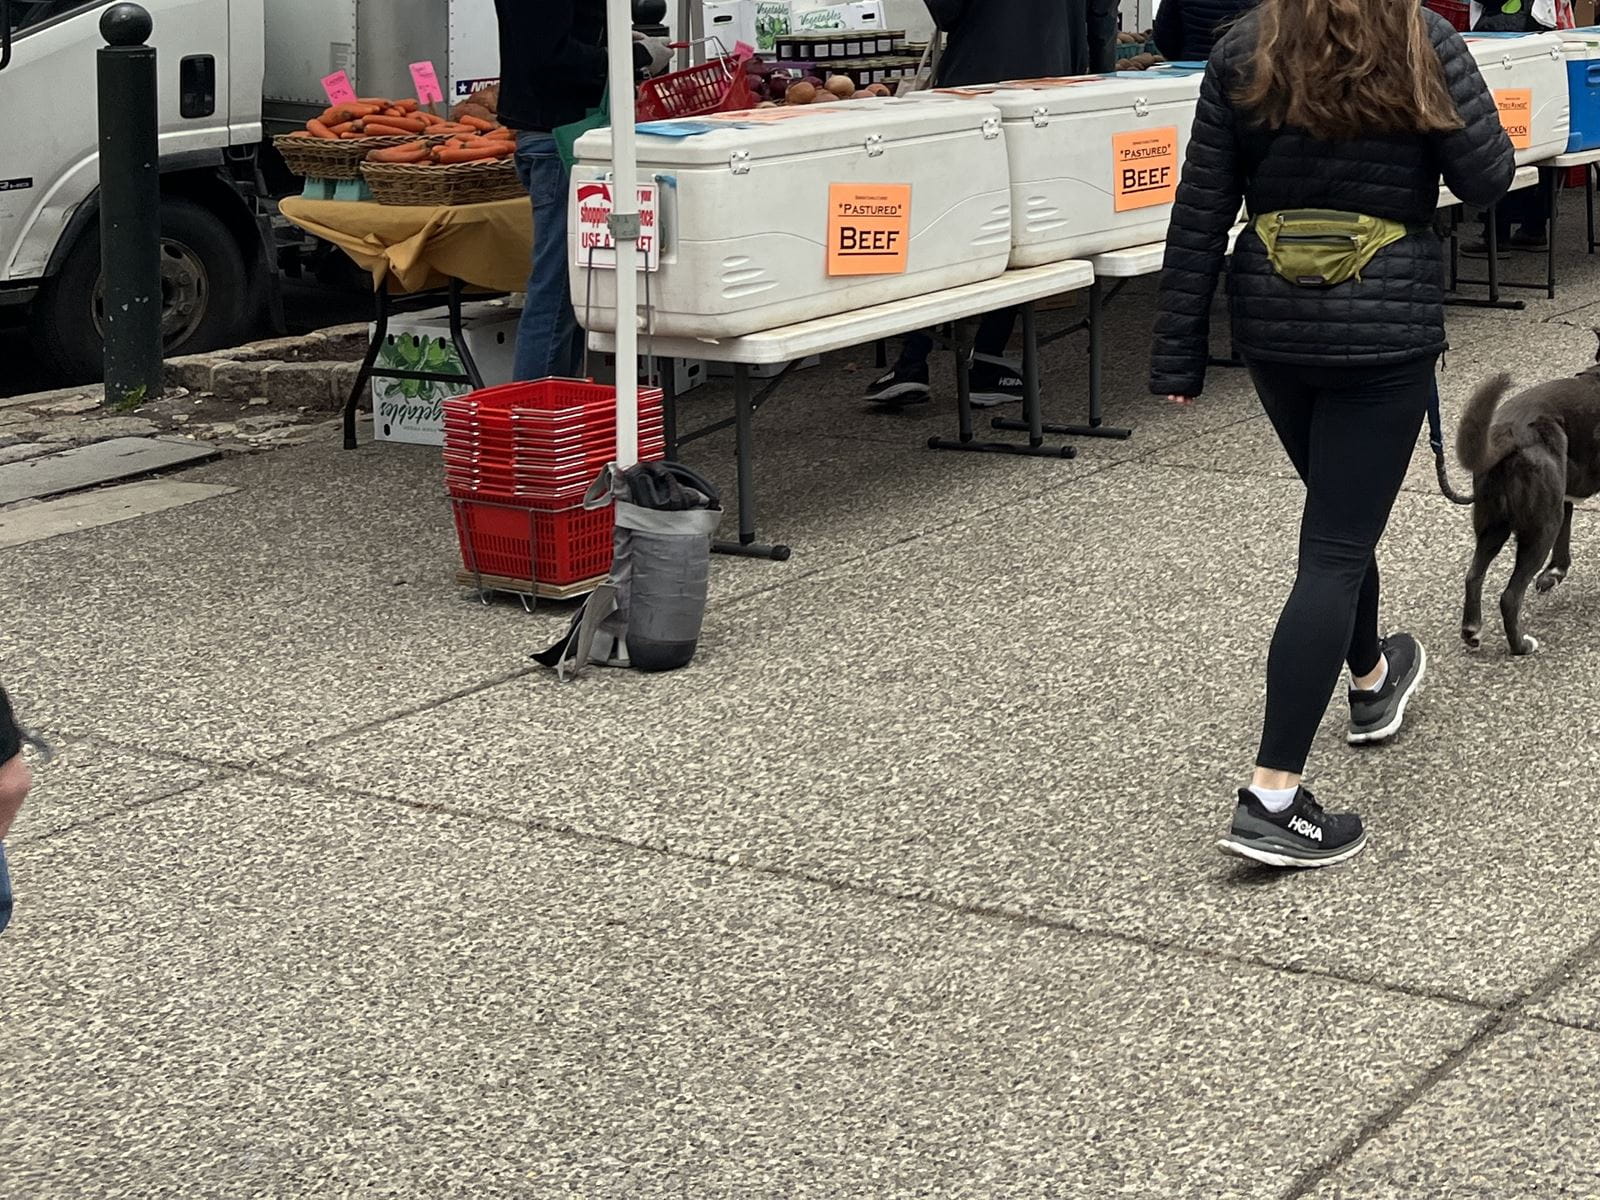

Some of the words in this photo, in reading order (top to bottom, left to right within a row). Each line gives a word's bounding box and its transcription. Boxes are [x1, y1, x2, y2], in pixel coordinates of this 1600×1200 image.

[755, 2, 789, 18] Vegetables
[800, 9, 842, 27] Vegetables
[1123, 166, 1170, 189] BEEF
[582, 232, 600, 249] USE
[604, 233, 611, 248] A
[840, 226, 900, 250] BEEF
[1287, 814, 1323, 842] HOKA
